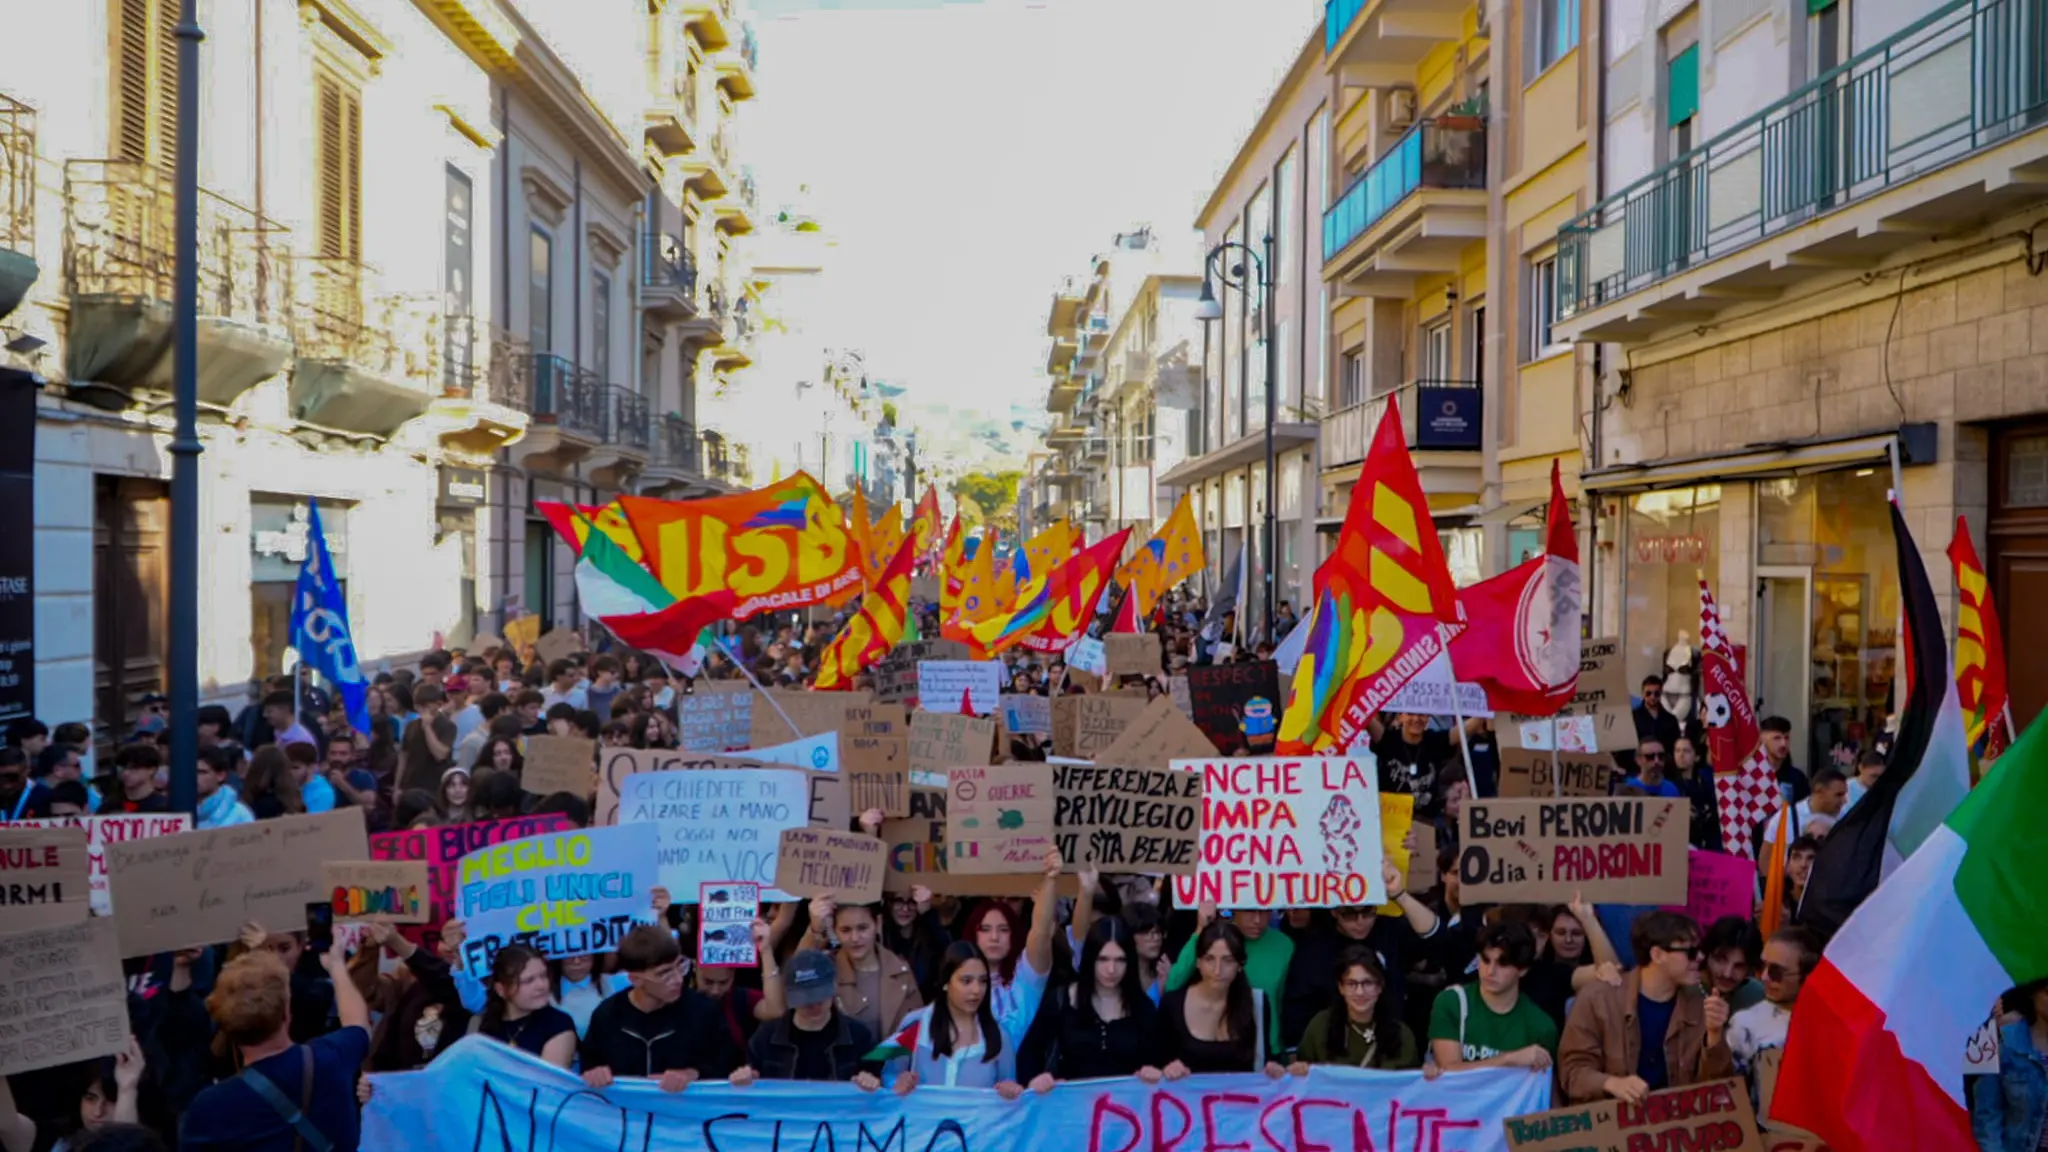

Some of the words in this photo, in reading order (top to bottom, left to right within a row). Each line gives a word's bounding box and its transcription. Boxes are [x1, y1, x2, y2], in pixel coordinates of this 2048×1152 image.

[658, 494, 847, 600] USB
[1192, 664, 1271, 686] RESPECT
[1710, 664, 1753, 726] REGGINA
[636, 780, 655, 799] CI
[760, 781, 776, 797] DI
[1182, 763, 1302, 795] NCHE
[1322, 760, 1367, 790] LA
[1531, 758, 1608, 790] BOMBE
[740, 803, 789, 821] MANO
[1055, 794, 1194, 831] PRIVILEGIO
[1202, 798, 1297, 830] IMPA
[1469, 806, 1526, 838] Bevi
[1539, 802, 1644, 838] PERONI
[727, 829, 758, 842] NOI
[1085, 830, 1125, 863] STA
[1129, 836, 1195, 864] BENE
[1198, 834, 1301, 865] OGNA
[462, 835, 591, 884] MEGLIO
[723, 851, 775, 883] VOC
[1460, 845, 1527, 885] Odia
[1537, 863, 1544, 881] i
[1552, 843, 1663, 882] PADRONI
[462, 880, 536, 917] FIGLI
[545, 872, 634, 902] UNICI
[1176, 868, 1222, 904] UN
[1231, 870, 1367, 905] FUTURO
[516, 901, 587, 932] CHE
